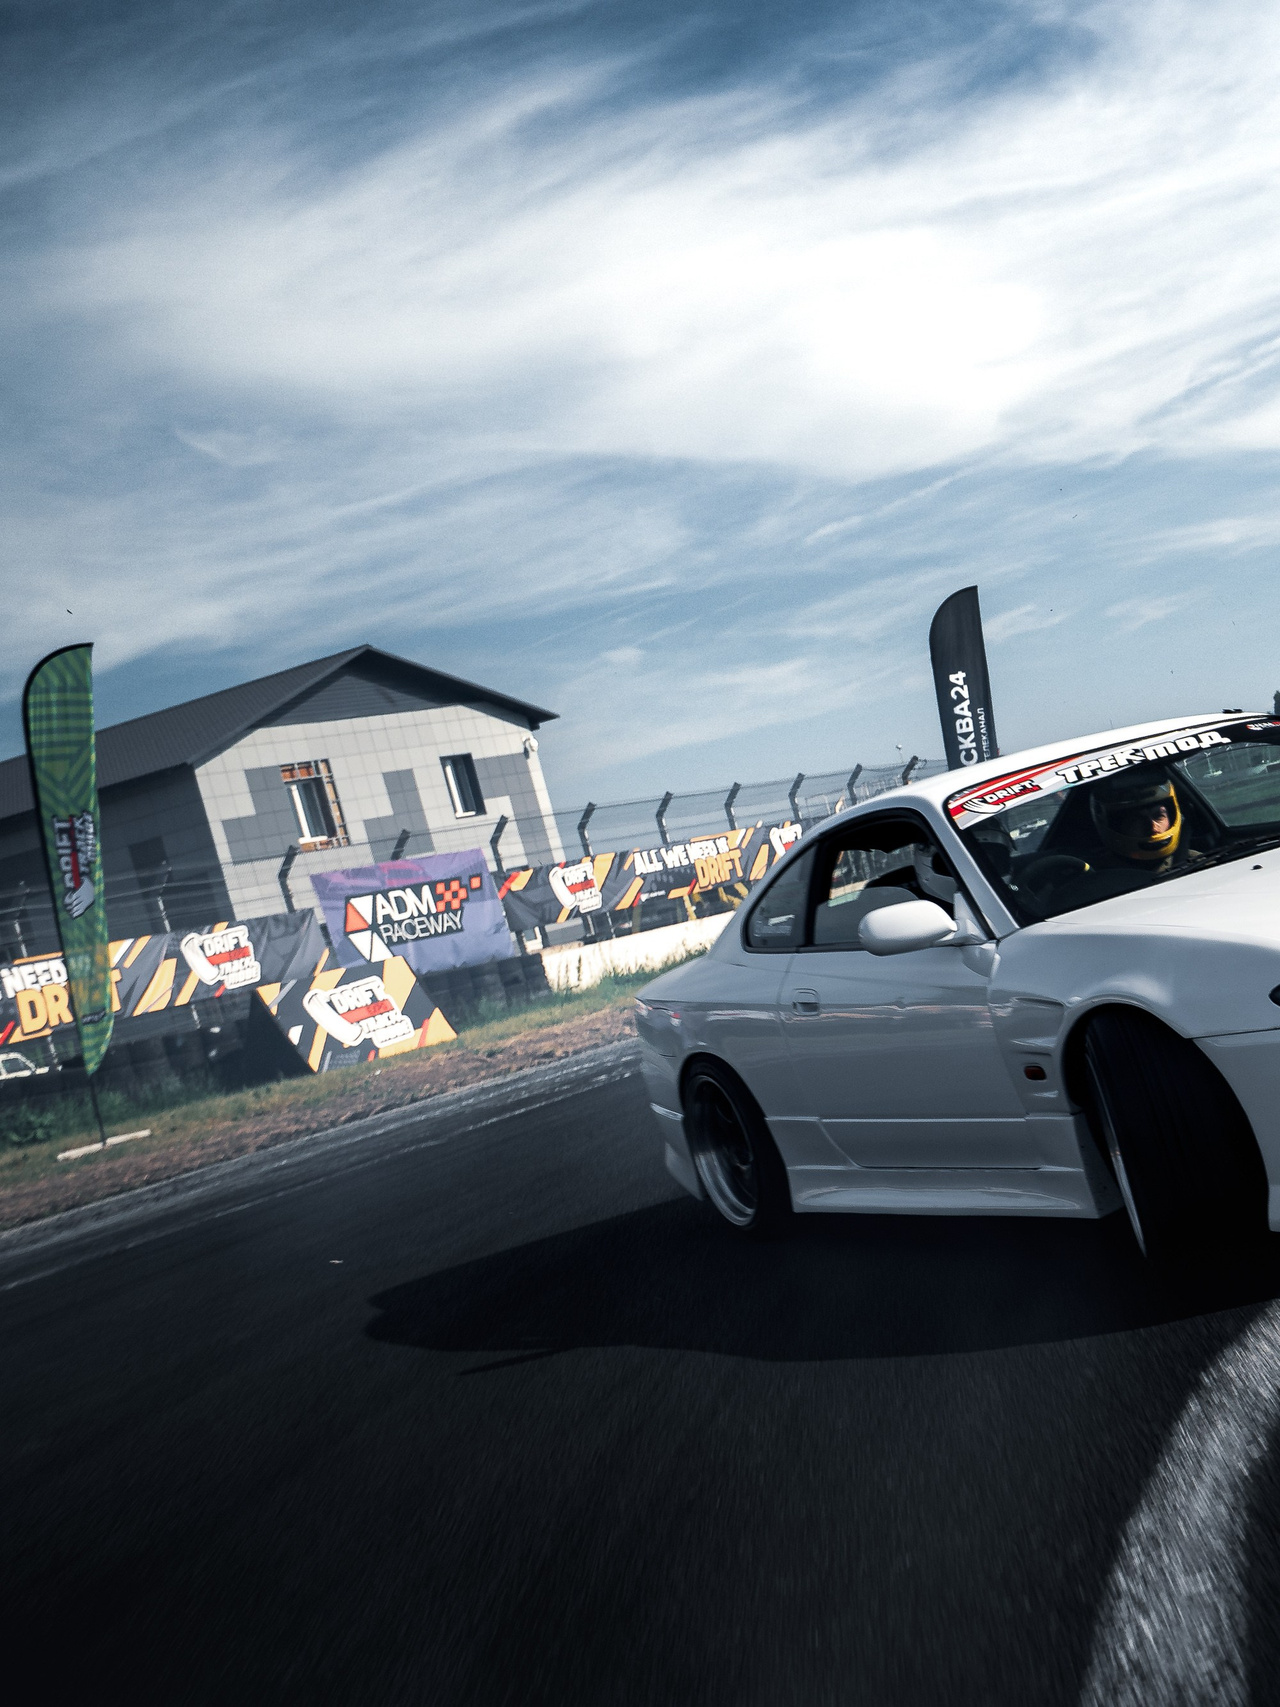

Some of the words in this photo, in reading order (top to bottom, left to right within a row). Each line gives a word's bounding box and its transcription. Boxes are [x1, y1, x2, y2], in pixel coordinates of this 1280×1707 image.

[948, 671, 979, 766] СКВА24
[983, 779, 1037, 803] DRIFT
[633, 848, 663, 875] ALL
[661, 844, 690, 868] WE
[694, 848, 744, 888] DRIFT
[376, 884, 437, 925] ADM
[203, 930, 247, 957] DRIFT
[378, 909, 463, 945] RACEWAY
[0, 958, 68, 999] NEED
[328, 980, 383, 1015] DRIFT
[16, 967, 122, 1036] DRT
